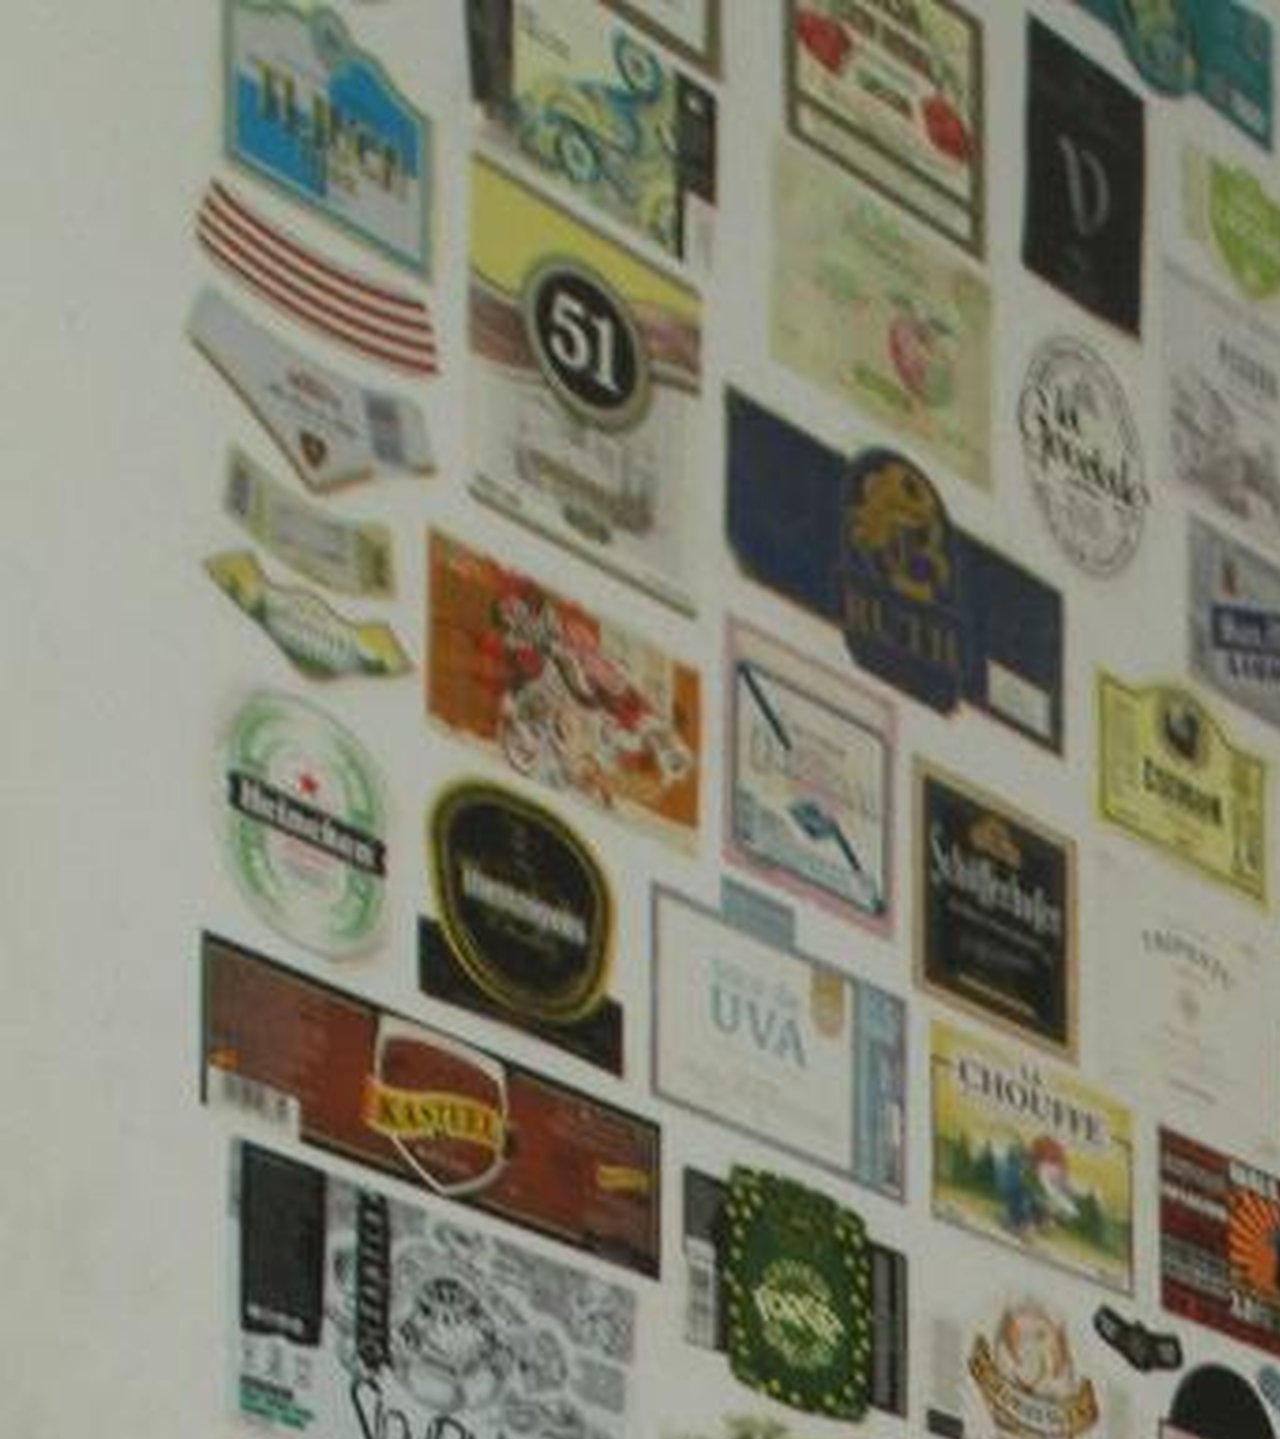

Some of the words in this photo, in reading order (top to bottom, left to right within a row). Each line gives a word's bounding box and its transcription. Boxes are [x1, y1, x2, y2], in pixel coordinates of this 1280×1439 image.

[550, 292, 620, 395] 51
[711, 988, 808, 1070] UVA
[956, 1054, 1106, 1148] CHOUFFE
